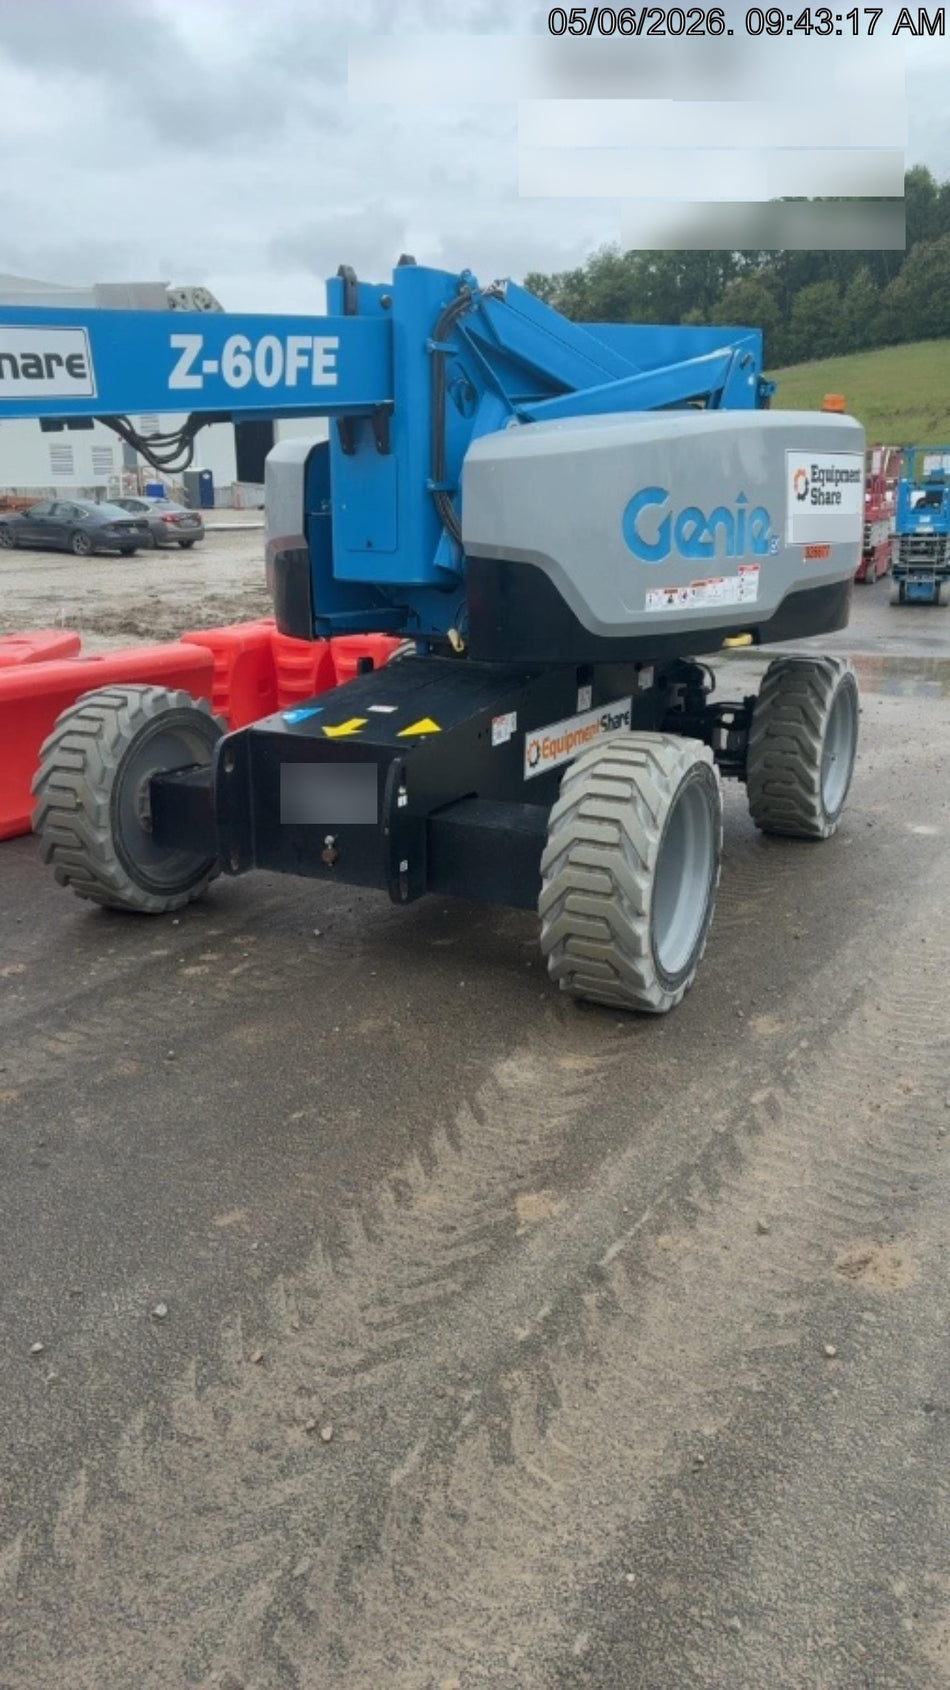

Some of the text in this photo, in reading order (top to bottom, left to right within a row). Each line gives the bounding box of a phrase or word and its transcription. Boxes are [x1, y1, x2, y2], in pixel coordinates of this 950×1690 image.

[168, 334, 339, 390] Z-60FE
[810, 464, 861, 487] Equipment
[810, 487, 842, 506] Share
[622, 486, 771, 565] Genie
